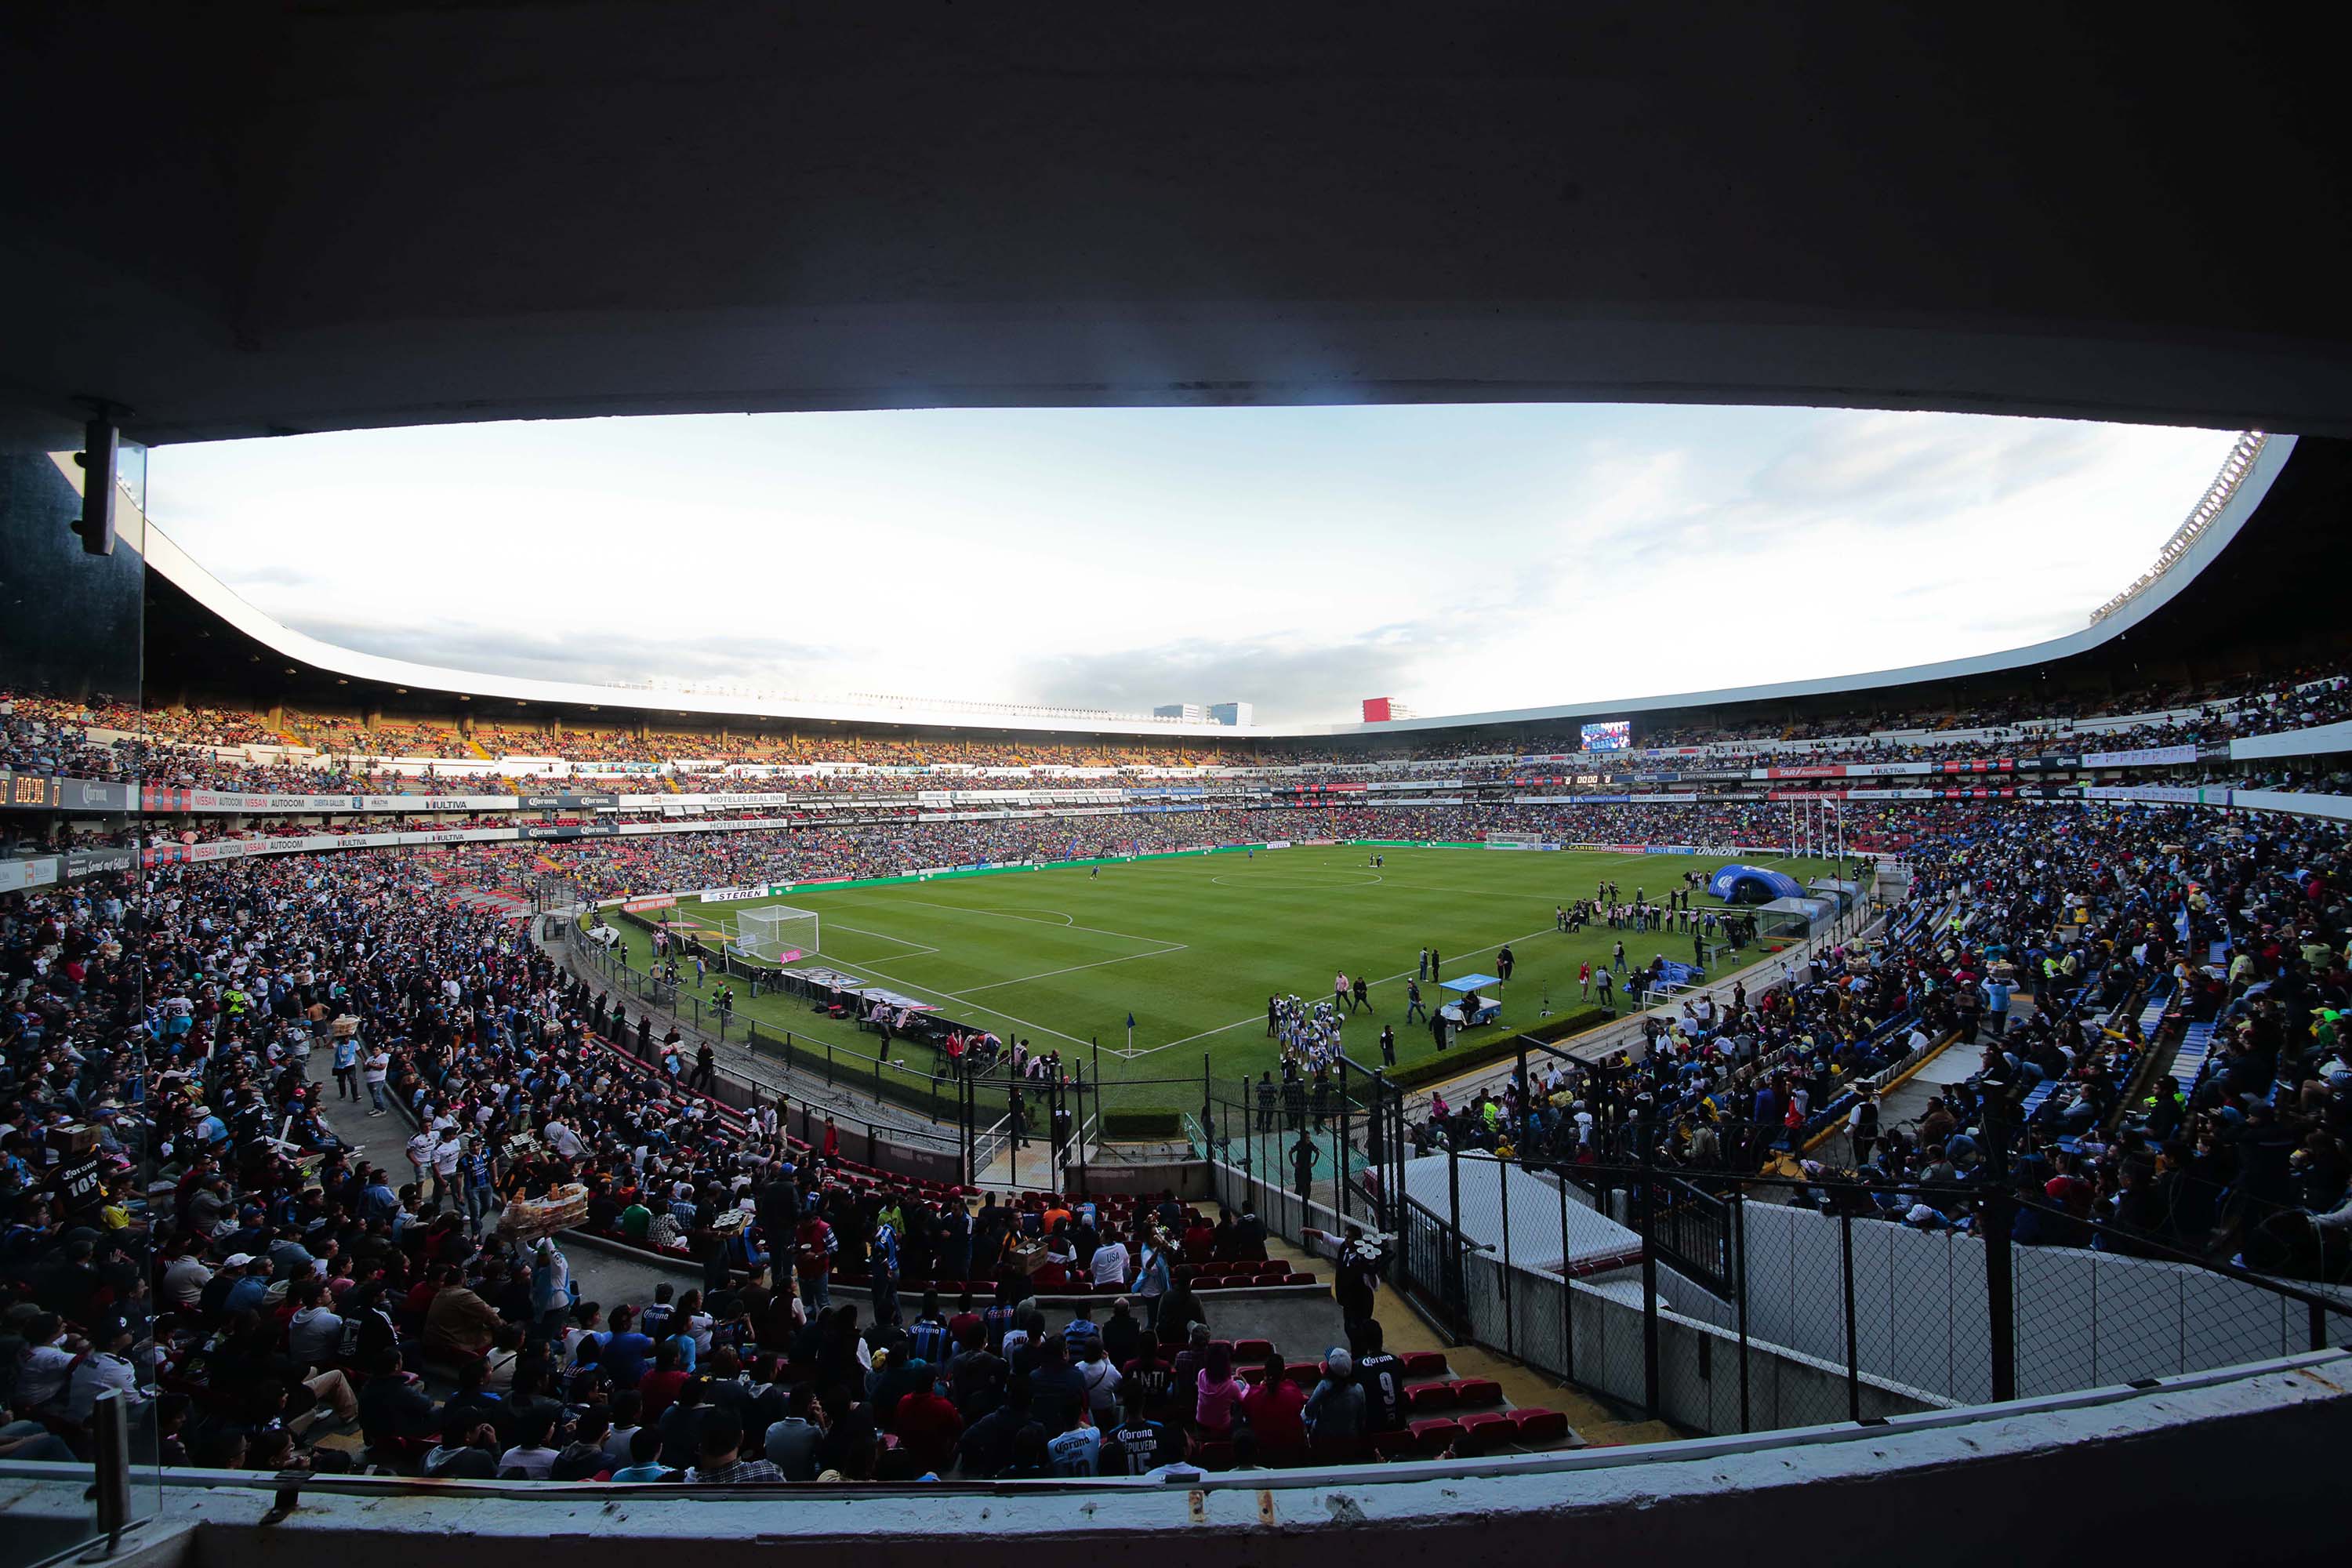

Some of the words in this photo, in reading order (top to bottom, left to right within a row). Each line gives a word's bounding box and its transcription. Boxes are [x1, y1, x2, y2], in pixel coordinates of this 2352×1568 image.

[1871, 765, 1906, 774] MULTIVA
[195, 796, 216, 806] NISSAN
[220, 797, 242, 807] AUTOCOM
[245, 799, 267, 808] NISSAN
[426, 798, 467, 809] MULTIVA
[528, 797, 558, 806] Corona
[580, 797, 610, 806] Corona
[528, 828, 558, 837] Corona
[580, 826, 610, 834] Corona
[337, 838, 367, 848] MULTIVA
[195, 847, 216, 858] NISSAN
[220, 844, 241, 855] AUTOCOM
[244, 841, 267, 851] NISSAN
[270, 840, 303, 850] AUTOCOM
[719, 890, 762, 900] STEREN
[1107, 1252, 1120, 1263] USA
[644, 1308, 669, 1320] Corona
[911, 1325, 939, 1335] Corona
[1362, 1355, 1393, 1367] Corona
[1379, 1371, 1396, 1405] 9
[1117, 1428, 1154, 1443] Corona
[1054, 1436, 1091, 1455] Corona
[1125, 1439, 1157, 1453] EPULVEDA
